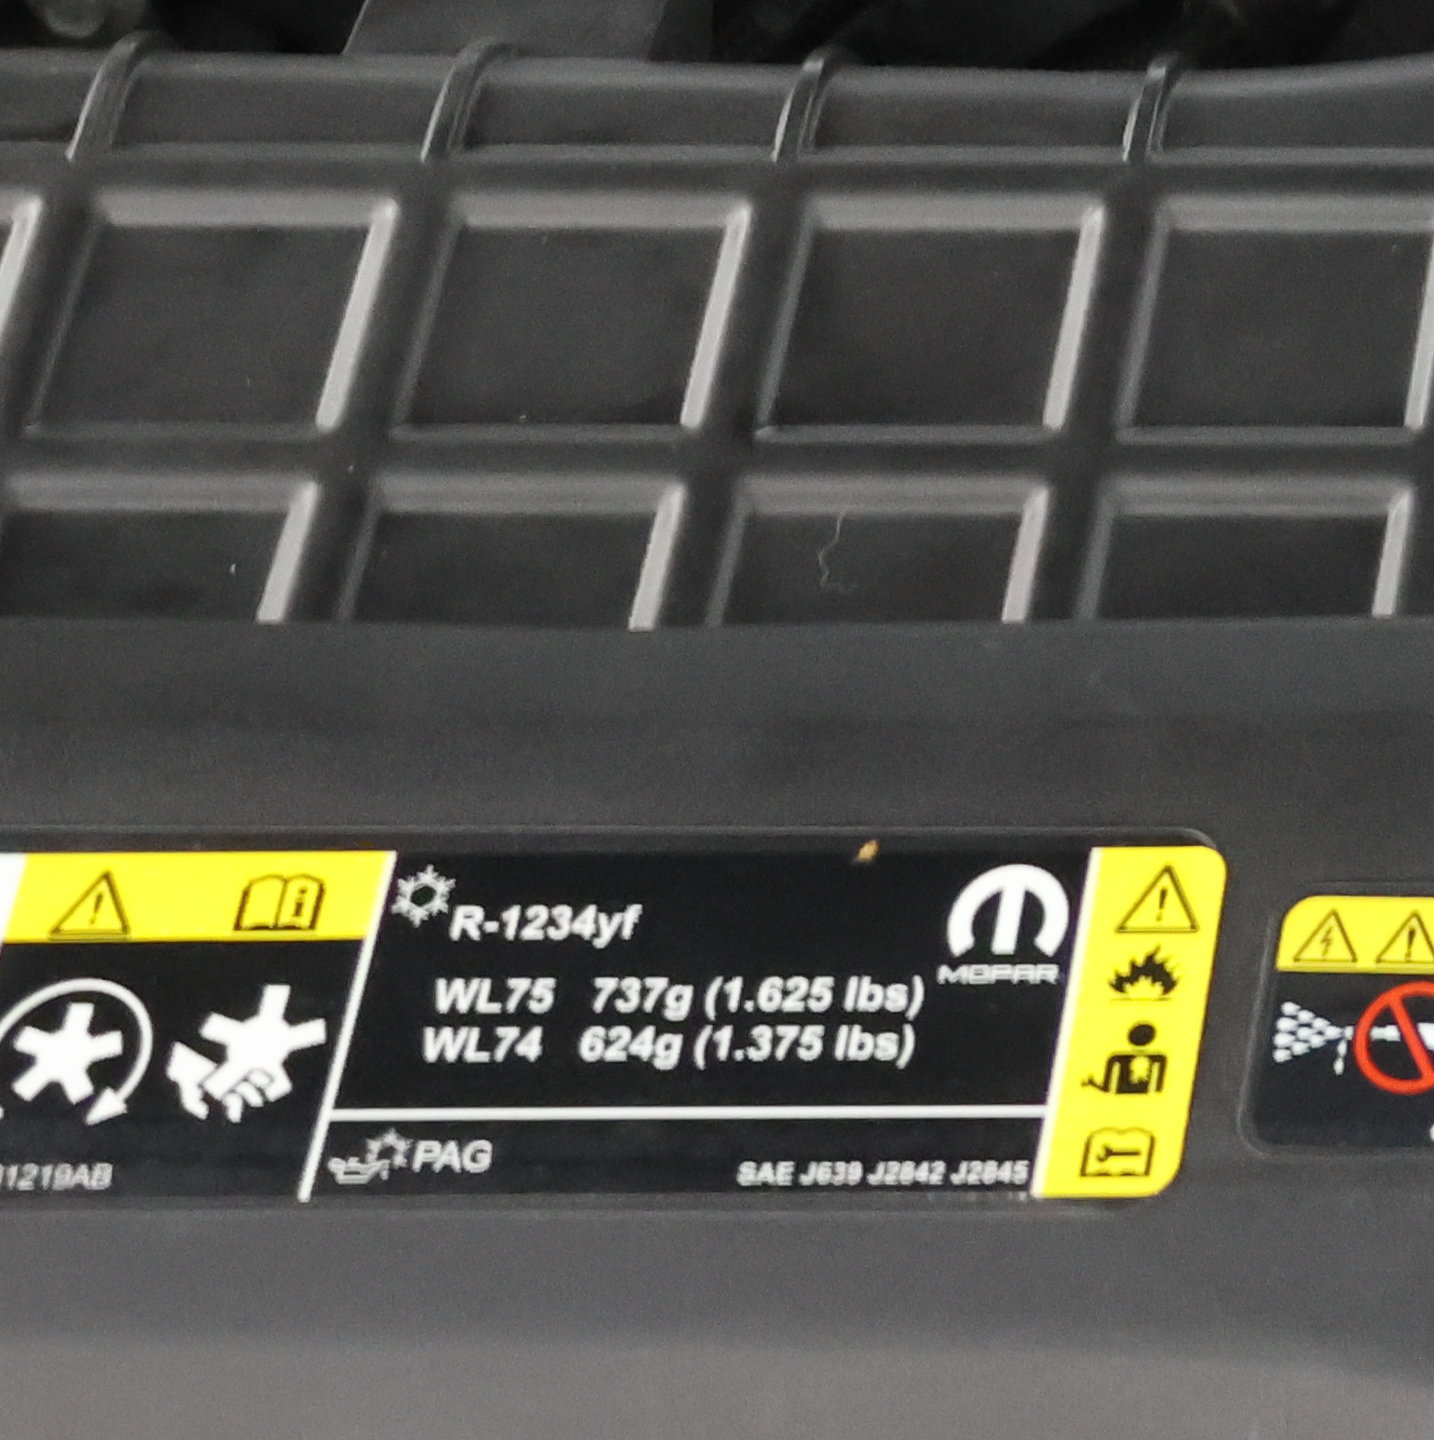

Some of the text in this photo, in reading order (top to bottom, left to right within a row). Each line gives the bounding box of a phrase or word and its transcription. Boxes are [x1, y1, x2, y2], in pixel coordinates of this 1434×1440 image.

[449, 903, 643, 949] R-1234yf
[936, 963, 1060, 985] MOPAR
[434, 974, 925, 1022] WL75 737g (1.625 lbs)
[422, 1023, 916, 1071] WL74 624g (1.375 lbs)
[412, 1139, 493, 1174] PAG
[736, 1160, 795, 1187] SAE
